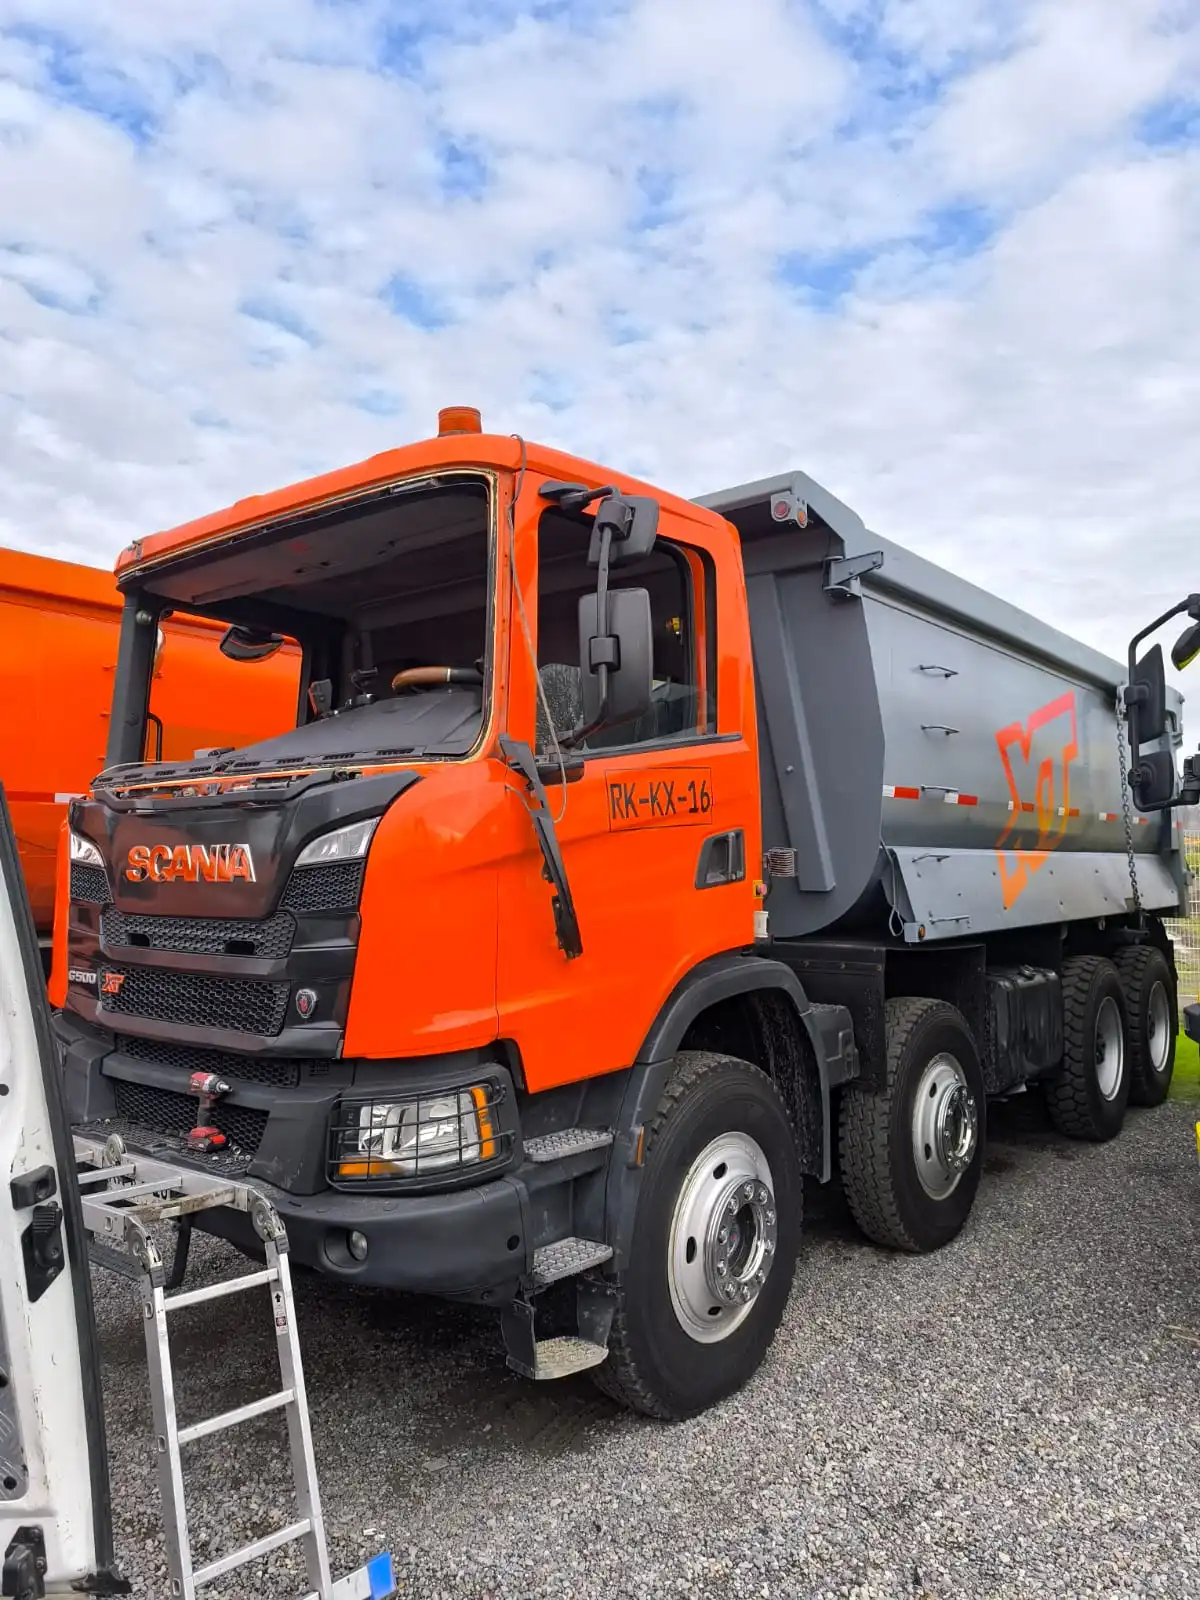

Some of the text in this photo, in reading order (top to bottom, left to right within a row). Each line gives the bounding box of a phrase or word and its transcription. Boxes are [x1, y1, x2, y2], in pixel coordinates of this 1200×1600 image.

[610, 780, 711, 819] RK-KX-16
[125, 843, 257, 882] SCANIA
[68, 970, 125, 993] G500 XT
